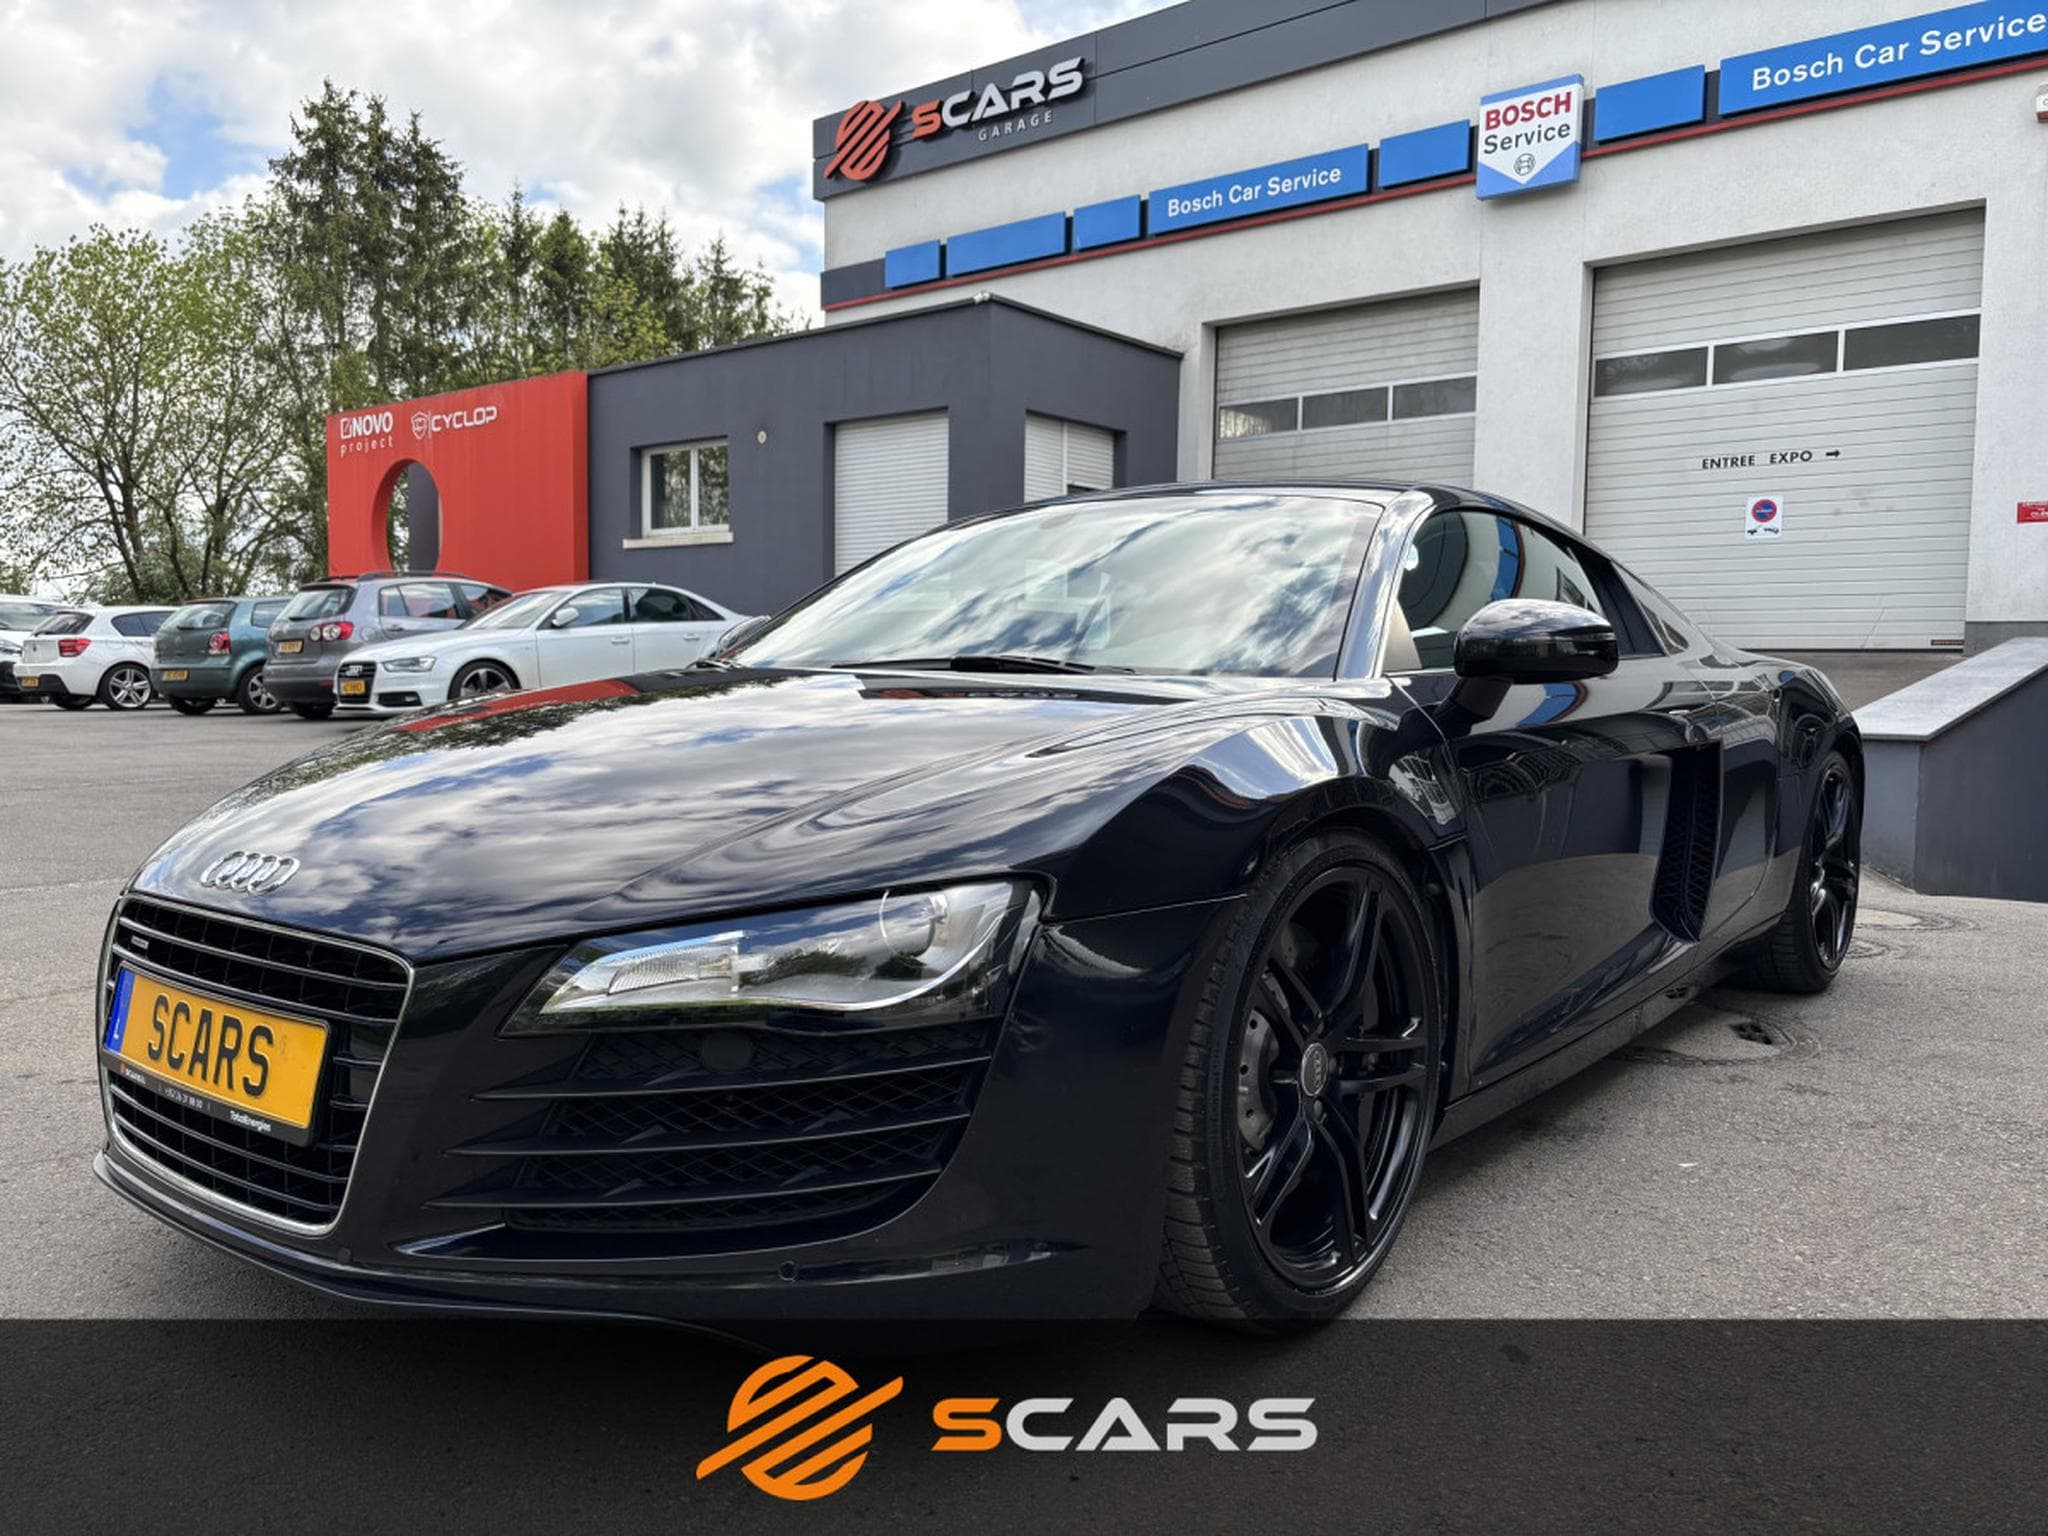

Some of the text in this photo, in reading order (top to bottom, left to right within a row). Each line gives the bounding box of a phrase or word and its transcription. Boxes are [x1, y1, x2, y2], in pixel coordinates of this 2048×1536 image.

[1751, 12, 2047, 91] Bosch Car Service
[911, 56, 1084, 139] SCARS
[1485, 91, 1572, 131] BOSCH
[978, 111, 1053, 141] GARAGE
[1483, 122, 1571, 154] Service
[1167, 167, 1342, 217] Bosch Car Service
[431, 405, 497, 433] CYCLOP
[340, 434, 393, 459] project
[1702, 450, 1813, 470] ENTREE EXPO
[148, 994, 274, 1097] SCARS
